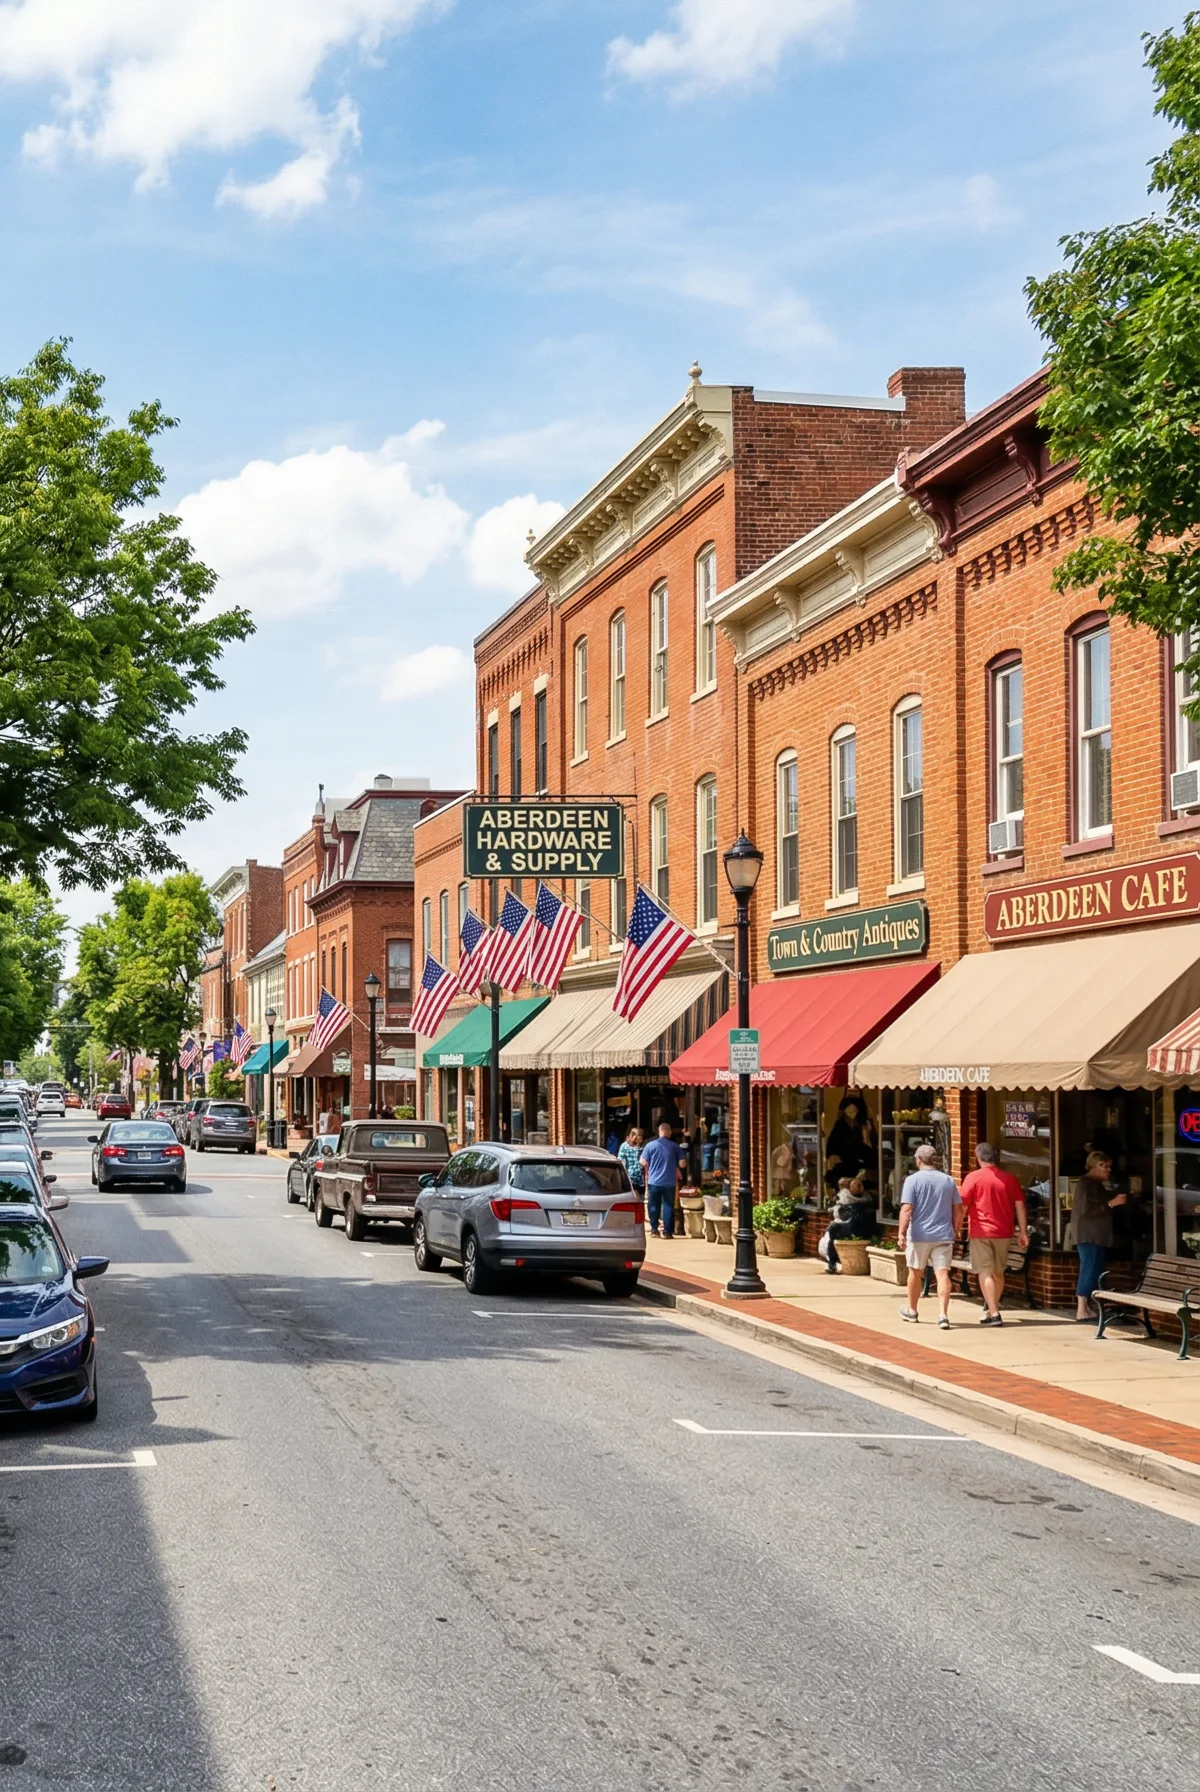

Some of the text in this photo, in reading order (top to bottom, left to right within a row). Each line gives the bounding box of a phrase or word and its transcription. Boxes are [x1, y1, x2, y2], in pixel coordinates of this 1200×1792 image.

[479, 810, 609, 829] ABERDEEN
[477, 831, 612, 850] HARDWARE
[485, 852, 603, 871] & SUPPLY
[996, 866, 1188, 931] ABERDEEN CAFE
[800, 929, 811, 956] &
[813, 926, 860, 955] Country
[862, 914, 920, 950] Antiques
